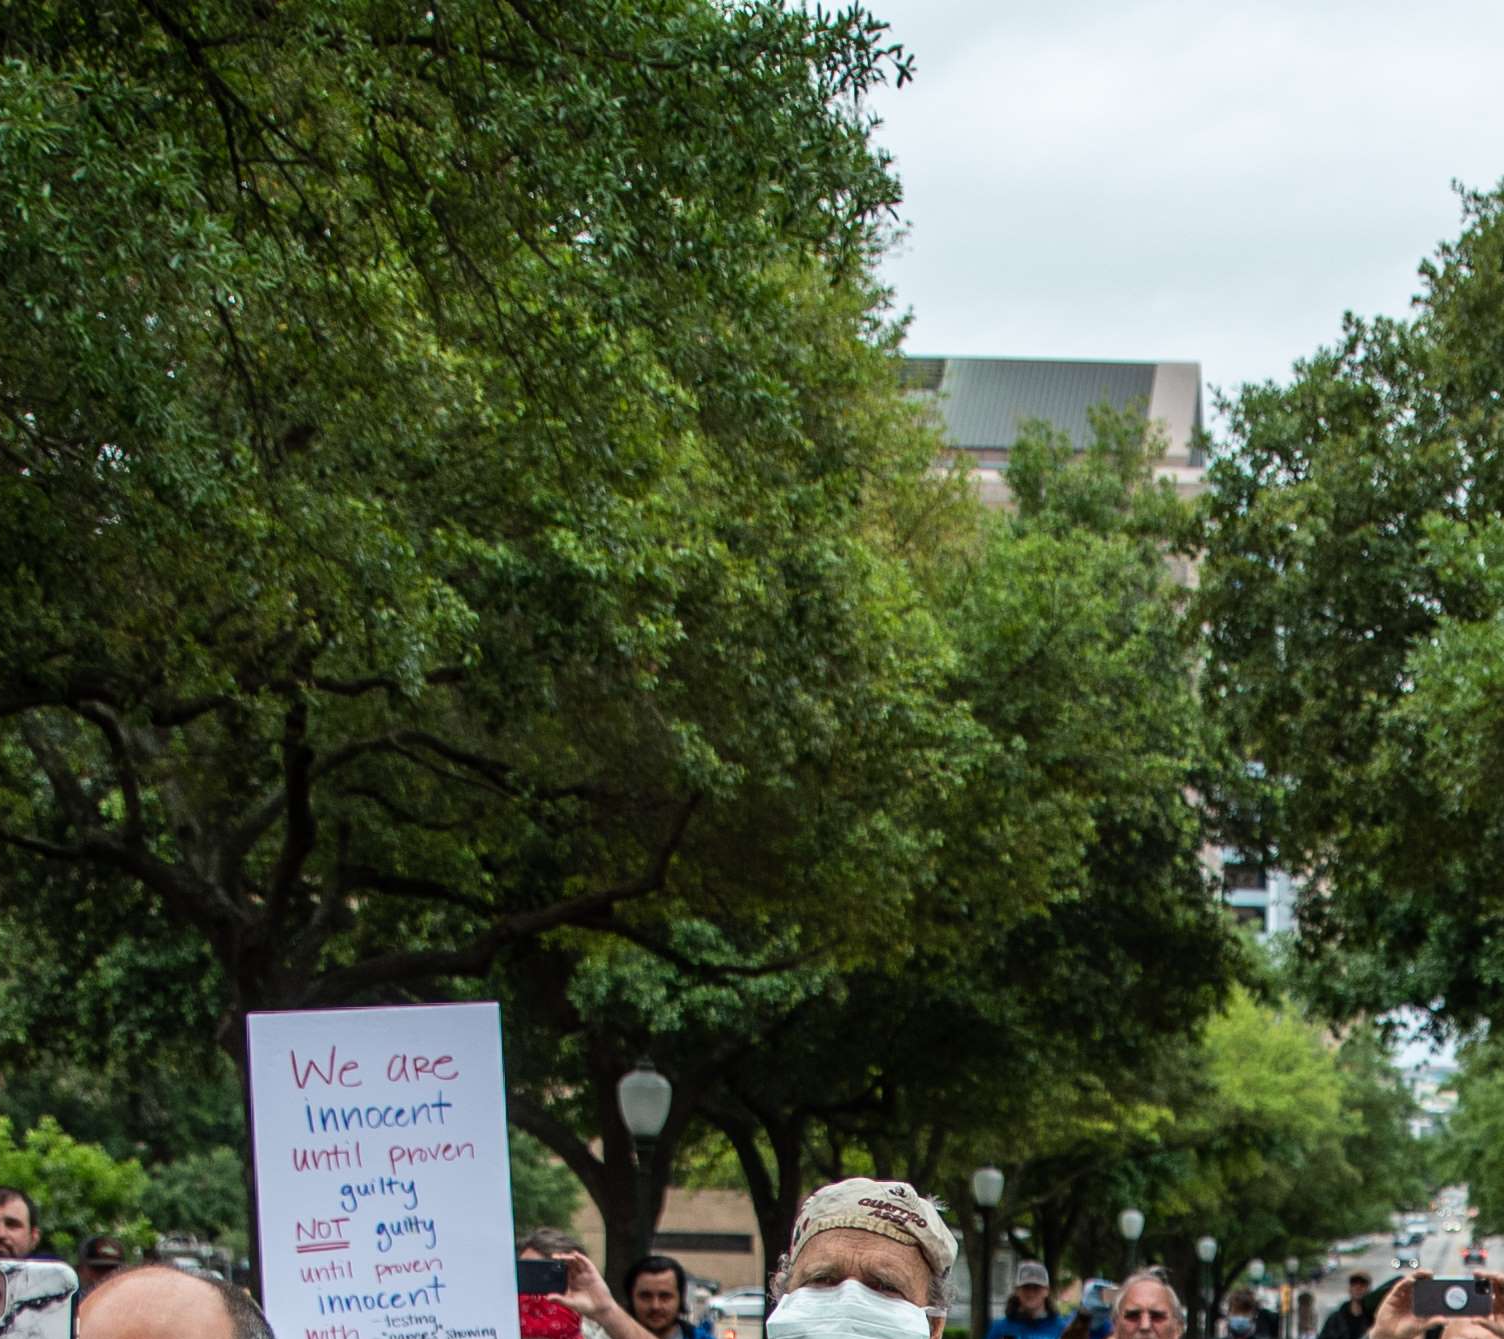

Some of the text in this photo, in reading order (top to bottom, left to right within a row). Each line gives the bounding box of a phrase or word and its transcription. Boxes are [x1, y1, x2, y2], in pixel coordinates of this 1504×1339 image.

[290, 1045, 362, 1089] We
[305, 1090, 452, 1133] innocent
[293, 1141, 474, 1175] until proven
[340, 1176, 418, 1212] guilty
[296, 1216, 437, 1252] NOT guilty
[301, 1257, 442, 1283] until proven
[318, 1276, 446, 1314] innocent
